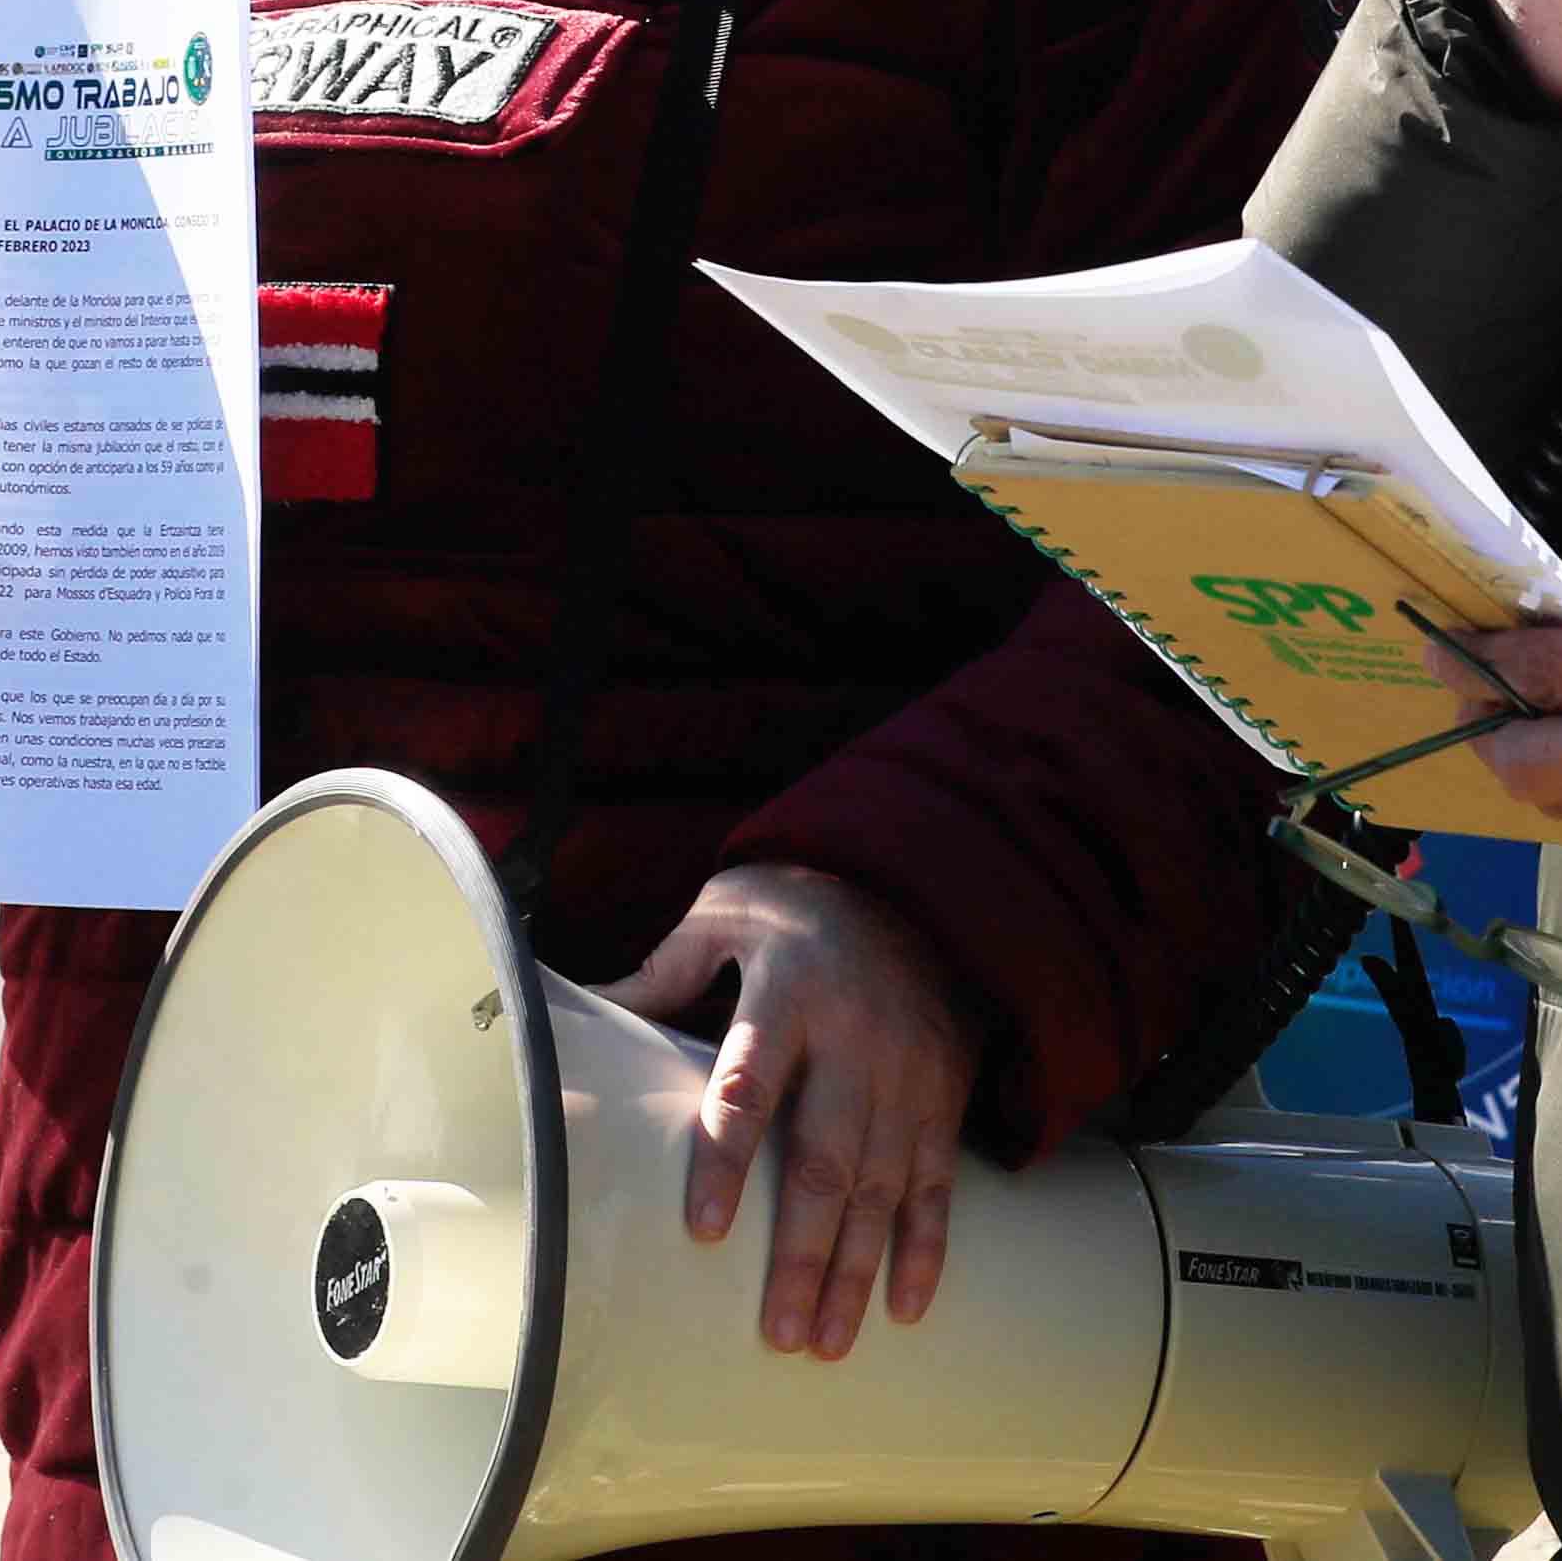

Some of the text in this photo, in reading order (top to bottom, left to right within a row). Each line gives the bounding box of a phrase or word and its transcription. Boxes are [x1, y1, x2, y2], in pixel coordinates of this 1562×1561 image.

[73, 74, 180, 111] TRABAJO
[4, 220, 20, 231] EL
[25, 219, 81, 232] PALACIO
[60, 240, 91, 252] 2023
[4, 294, 50, 307] delante
[8, 315, 62, 328] ministros
[1, 337, 50, 350] enteren
[28, 357, 41, 369] la
[2, 440, 37, 453] tener
[0, 462, 26, 472] con
[24, 588, 52, 601] para
[18, 628, 46, 640] este
[0, 648, 16, 660] de
[18, 649, 47, 662] todo
[0, 692, 25, 707] que
[29, 690, 48, 704] los
[10, 711, 35, 724] Nos
[14, 735, 45, 745] unas
[19, 756, 55, 767] como
